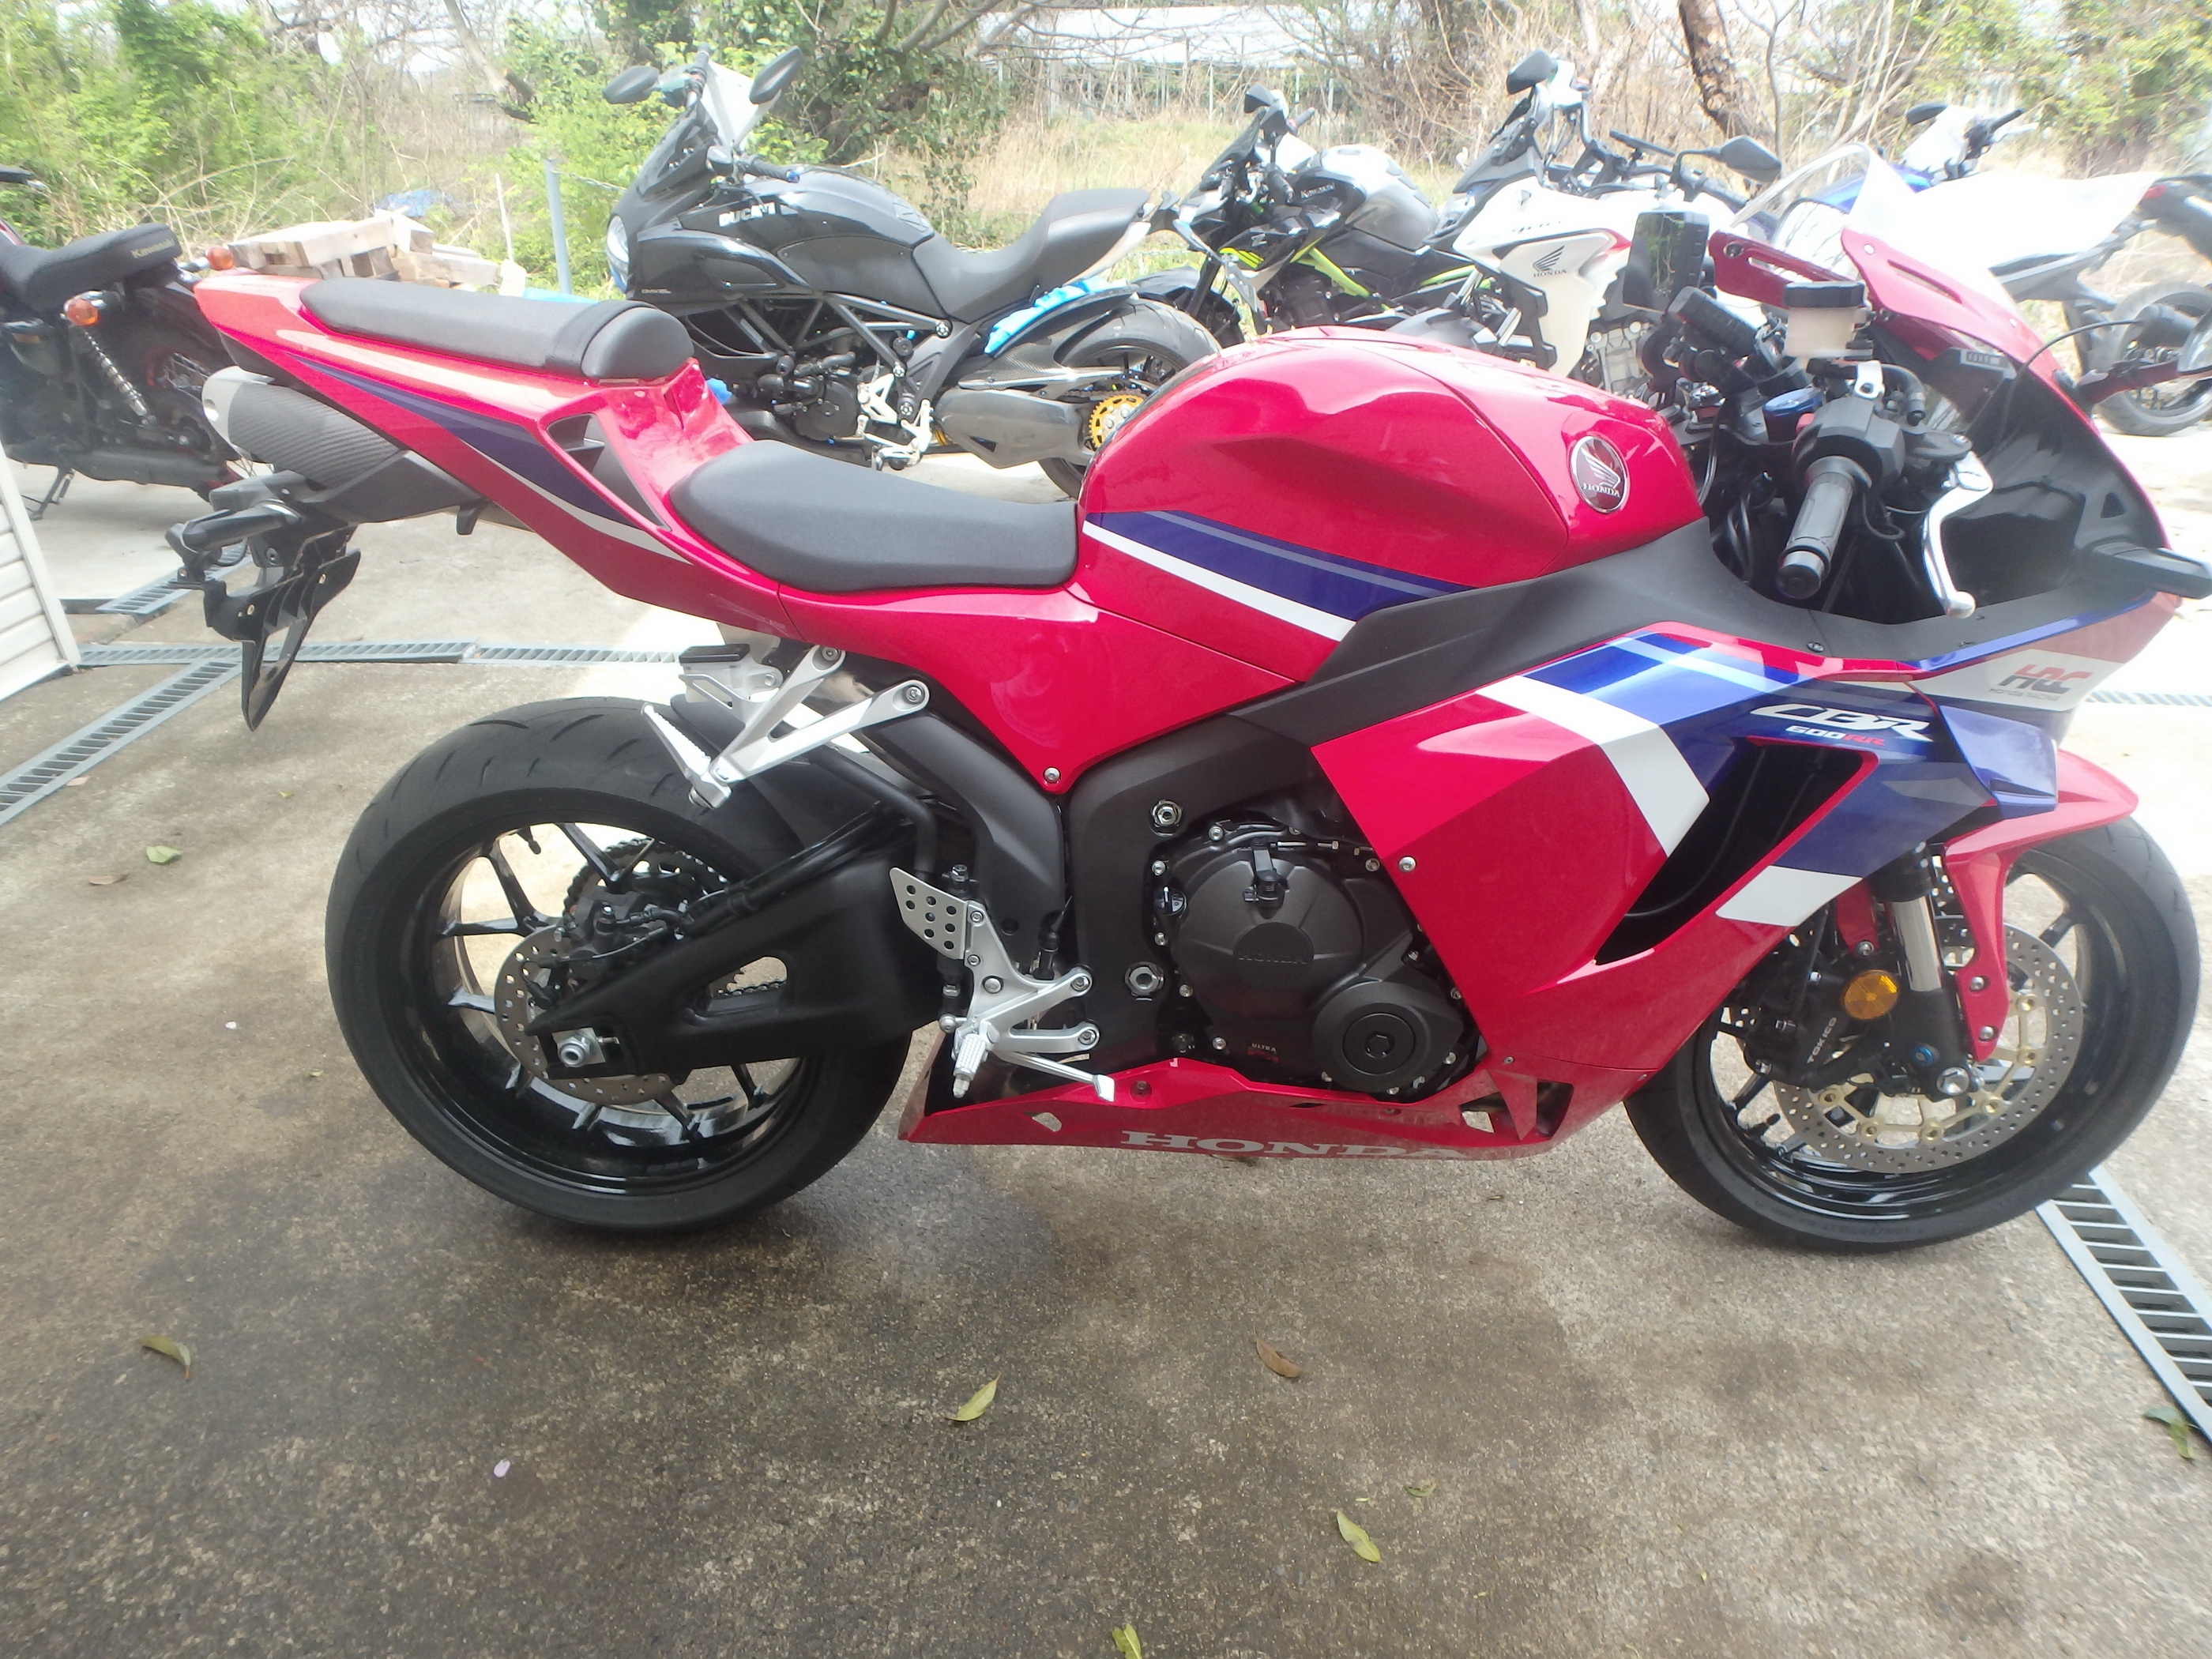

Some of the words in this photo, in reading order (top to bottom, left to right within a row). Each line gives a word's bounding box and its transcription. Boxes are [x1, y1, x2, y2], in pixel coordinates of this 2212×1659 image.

[718, 201, 776, 228] DUCATI
[1251, 233, 1268, 247] Z
[1533, 269, 1567, 278] HONDA
[1581, 482, 1620, 498] HONDA
[1997, 664, 2094, 694] HRC
[1750, 703, 1934, 743] CBR
[1785, 725, 1886, 747] 600RR
[1251, 1043, 1277, 1052] ULTRA
[1806, 1017, 1838, 1064] TOKICO
[1120, 1130, 1474, 1160] HONDA
